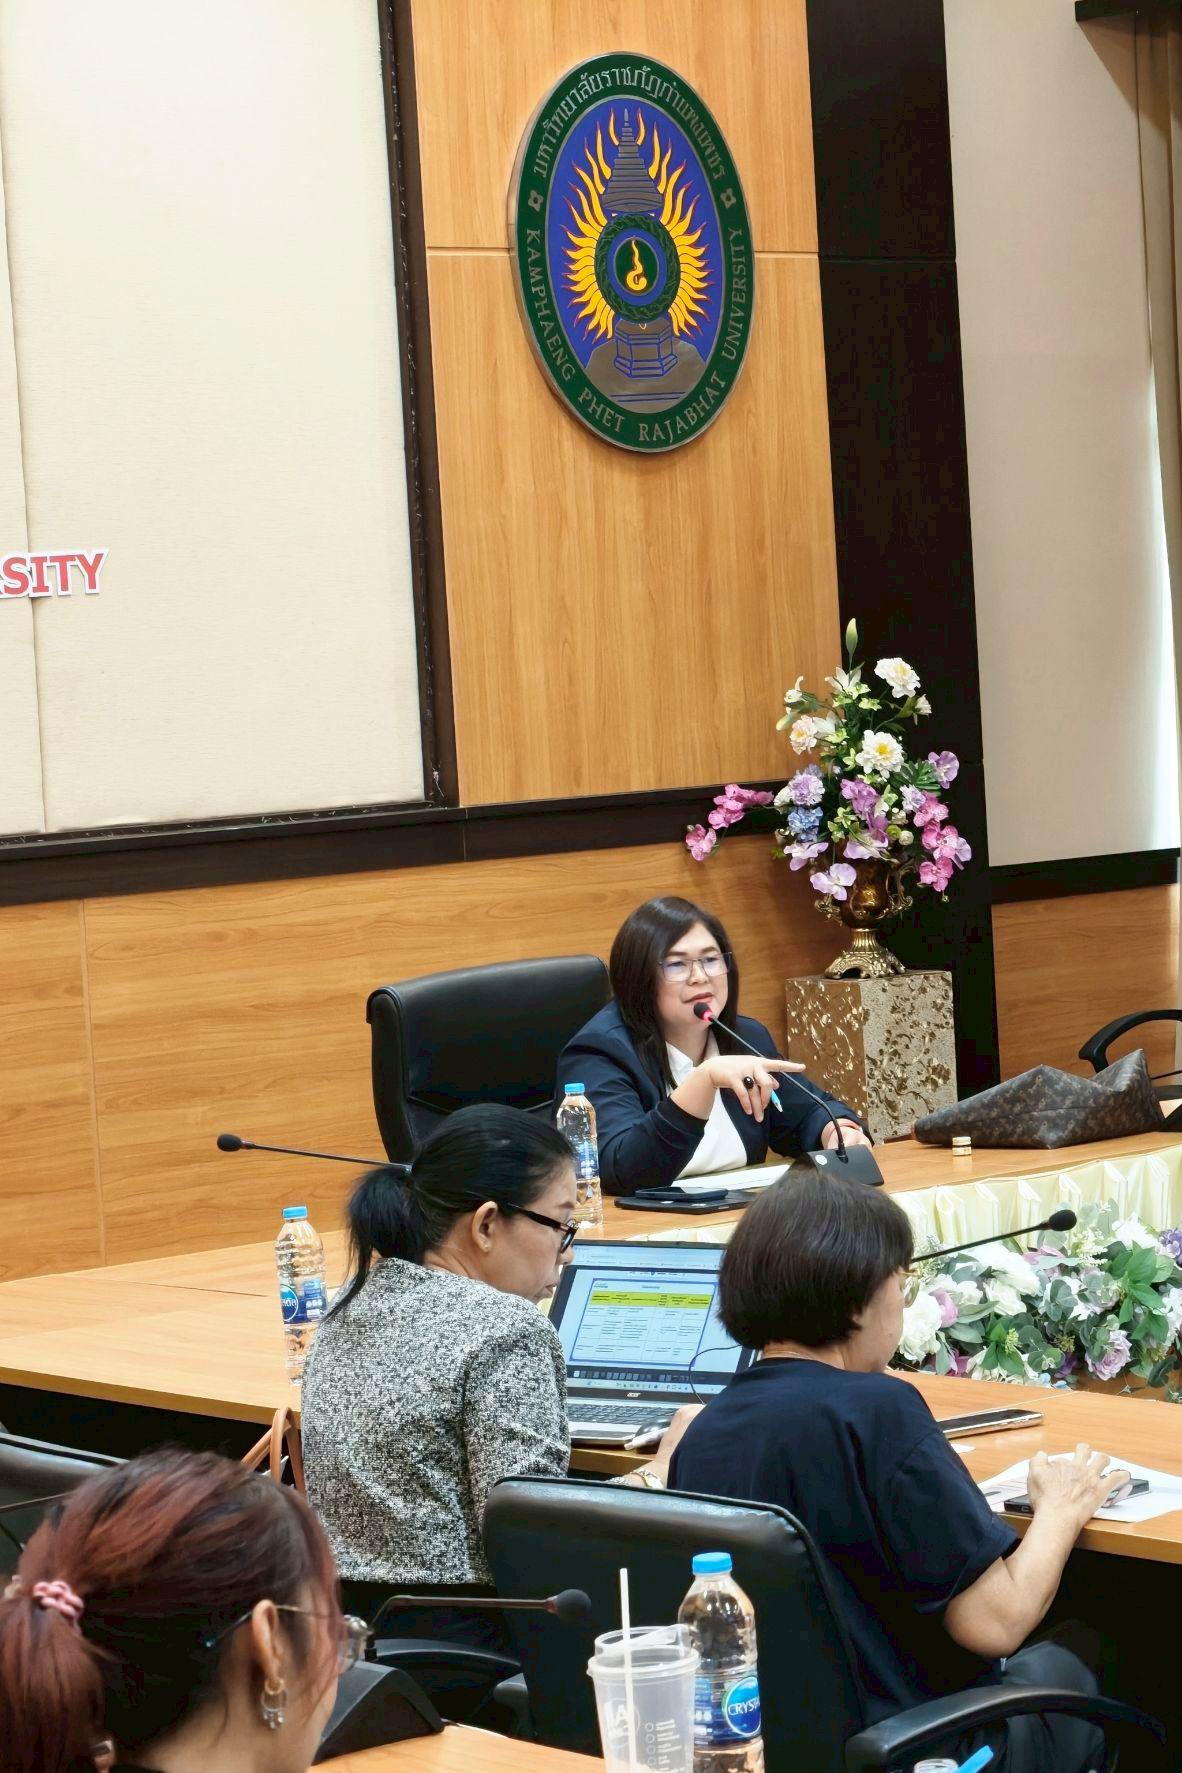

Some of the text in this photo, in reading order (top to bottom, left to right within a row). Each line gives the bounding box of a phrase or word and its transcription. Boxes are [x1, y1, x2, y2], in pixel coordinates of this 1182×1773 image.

[526, 227, 747, 444] KAMPHAENG PHET RAJABHAT UNIVERSITY
[0, 552, 105, 596] SITY
